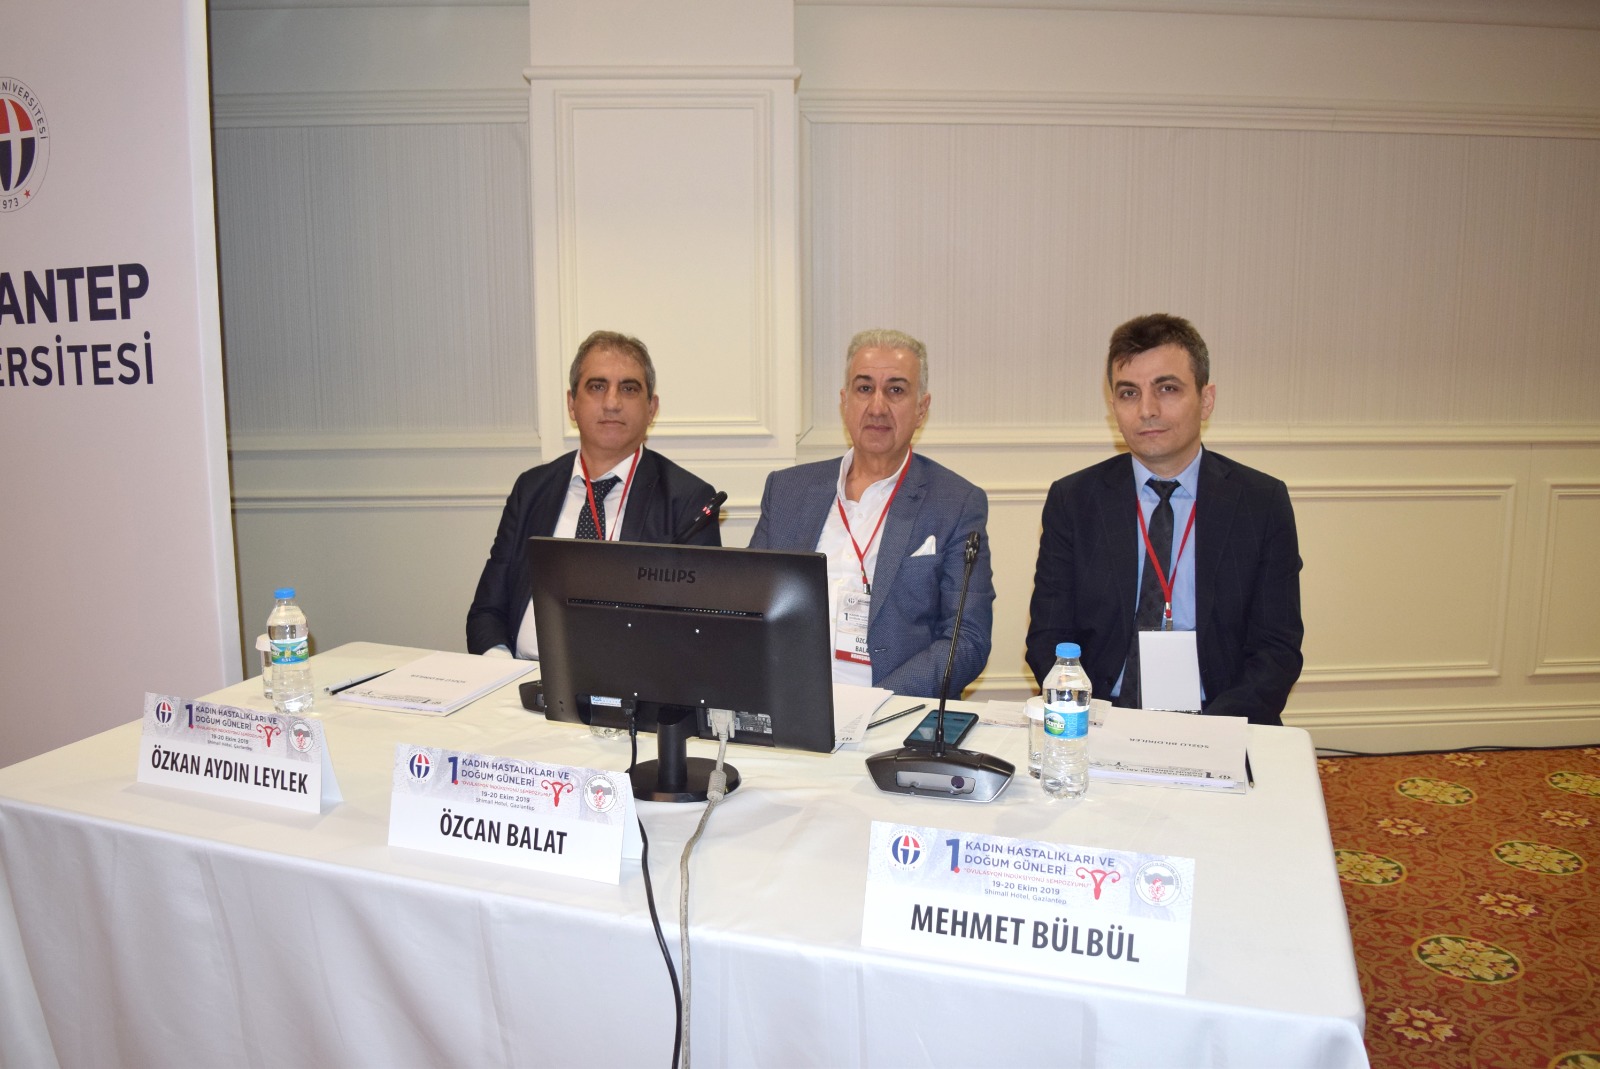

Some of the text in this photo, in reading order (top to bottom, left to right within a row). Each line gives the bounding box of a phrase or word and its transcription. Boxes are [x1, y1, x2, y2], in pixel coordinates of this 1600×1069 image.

[0, 79, 48, 140] NİVERSİTESİ
[0, 263, 150, 325] ANTEP
[0, 330, 154, 386] RSİTESİ
[638, 567, 696, 584] PHILIPS
[856, 636, 868, 644] ÖZC
[195, 705, 216, 715] KADIN
[219, 709, 266, 722] HASTALIKLARI
[195, 715, 251, 730] DOĞUM GÜNLERİ
[151, 744, 308, 794] ÖZKAN AYDIN LEYLEK
[461, 769, 535, 787] DOĞUM GÜNLERİ
[462, 758, 569, 780] KADIN HASTALIKLARI VE
[440, 808, 568, 854] ÖZCAN BALAT
[964, 854, 1067, 876] DOĞUM GÜNLERİ
[965, 841, 1115, 867] KADIN HASTALIKLARI VE
[984, 888, 1009, 897] Shimall
[1032, 894, 1067, 905] Gaziantep
[992, 880, 1060, 896] 19-20 Ekim 2019
[910, 903, 1140, 963] MEHMET BÜLBÜL
